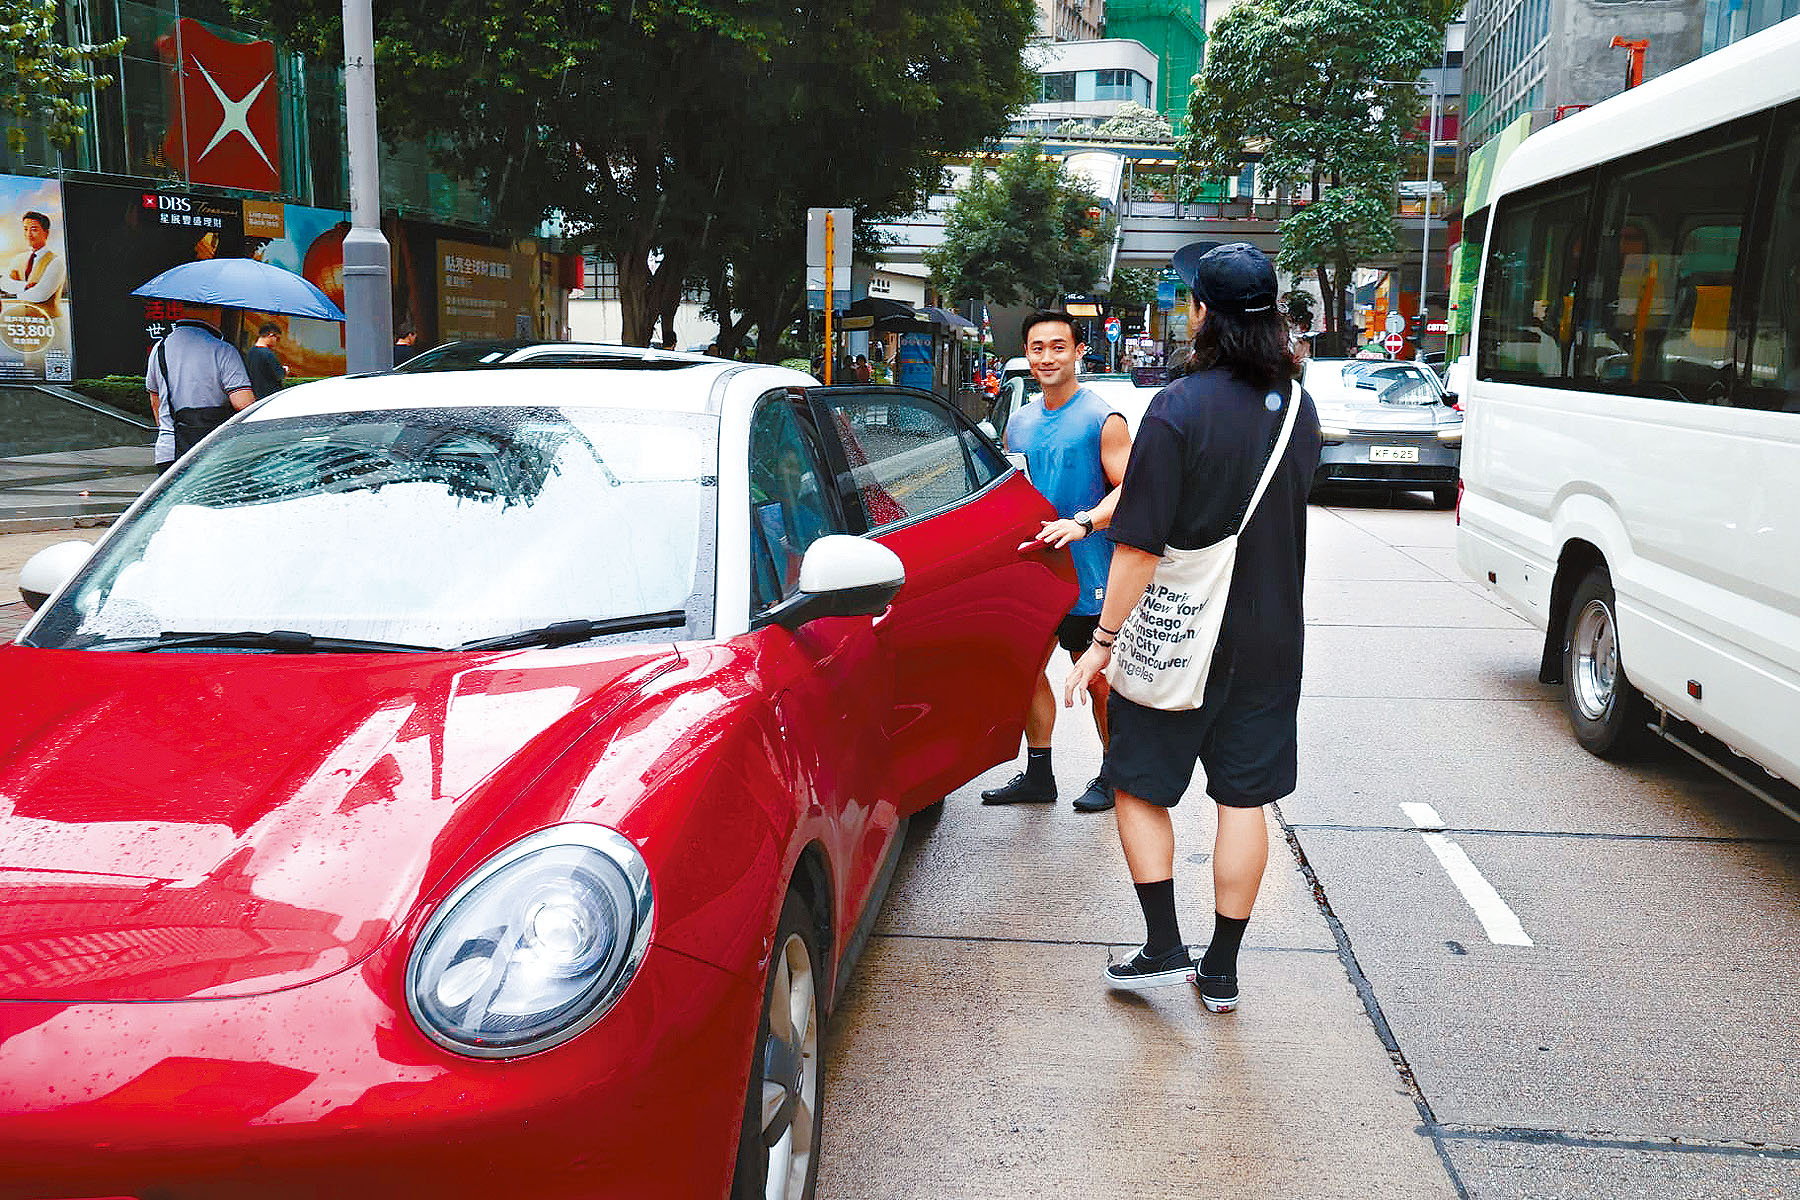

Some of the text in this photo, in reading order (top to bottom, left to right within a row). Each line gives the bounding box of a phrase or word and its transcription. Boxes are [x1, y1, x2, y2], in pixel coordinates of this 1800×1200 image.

[158, 195, 192, 212] DBS
[7, 323, 55, 338] 53,800
[1375, 449, 1414, 459] KF 625
